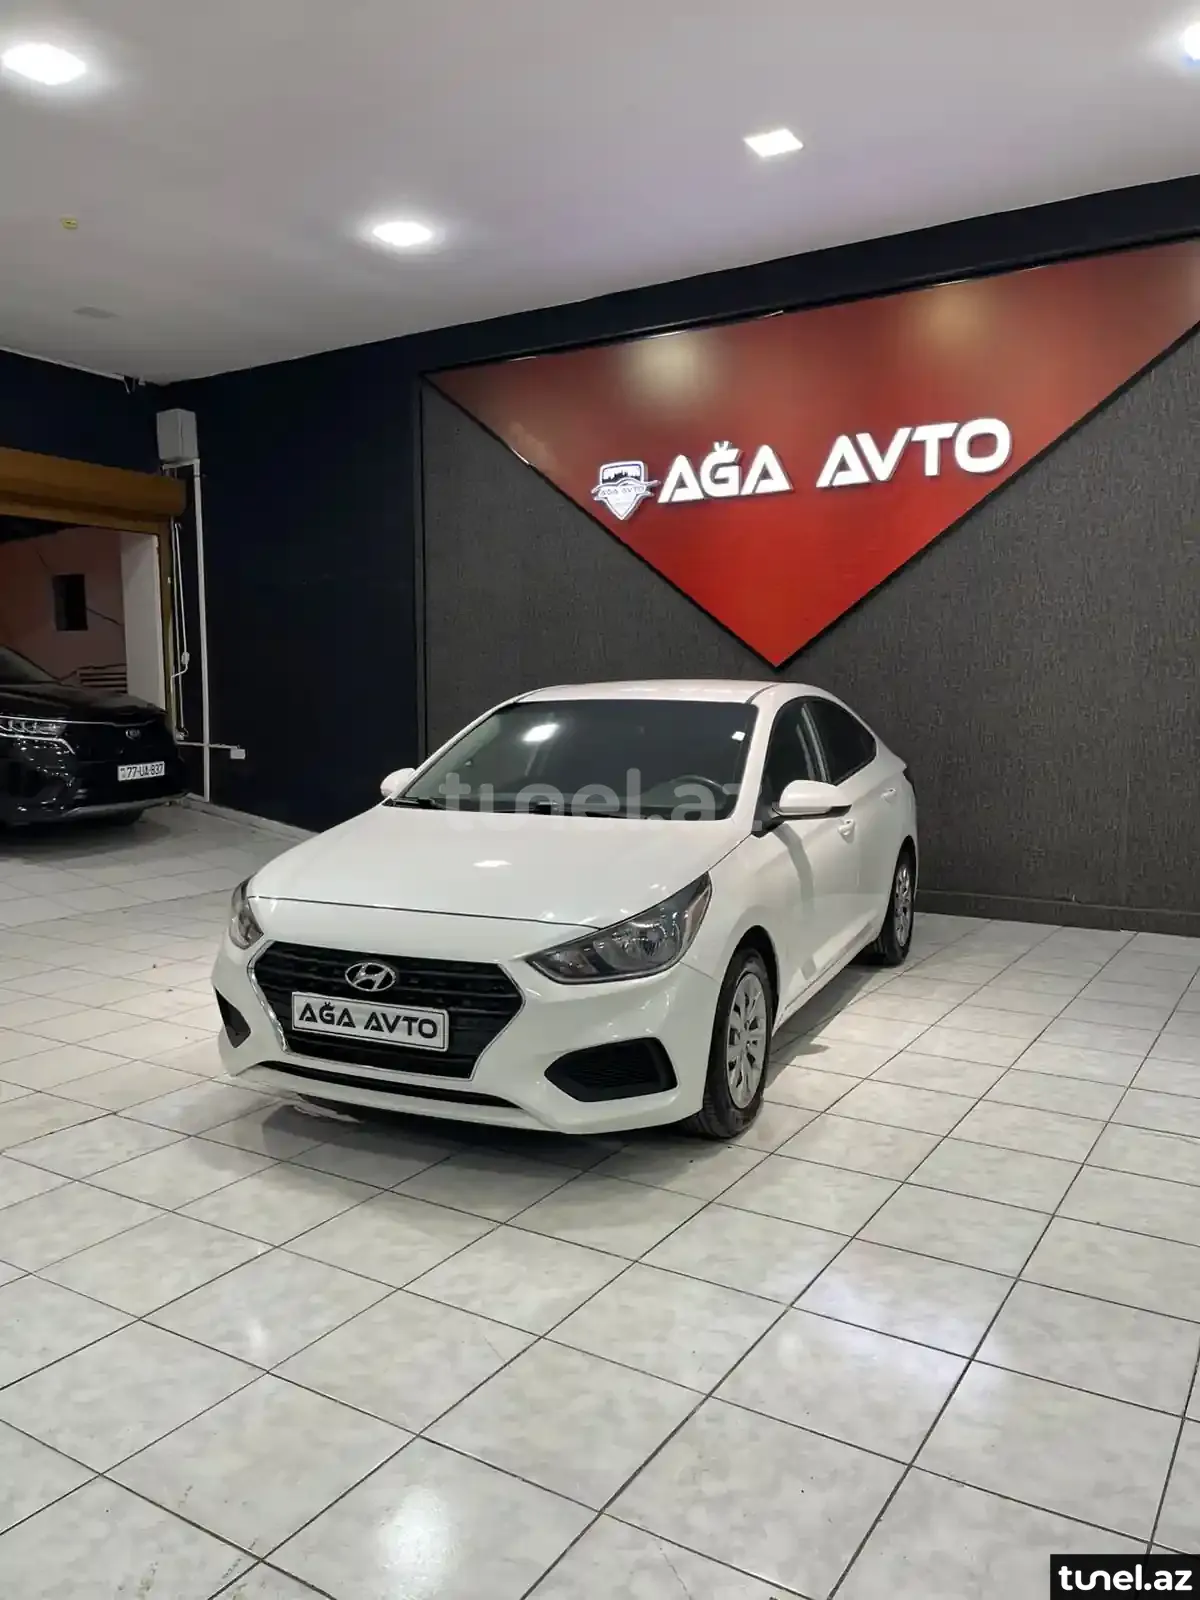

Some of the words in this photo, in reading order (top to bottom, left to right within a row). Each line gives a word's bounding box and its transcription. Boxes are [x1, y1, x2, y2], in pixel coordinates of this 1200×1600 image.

[658, 441, 794, 503] AĞA
[816, 418, 1012, 488] AVTO
[299, 1002, 355, 1028] AĞA
[363, 1012, 437, 1038] AVTO
